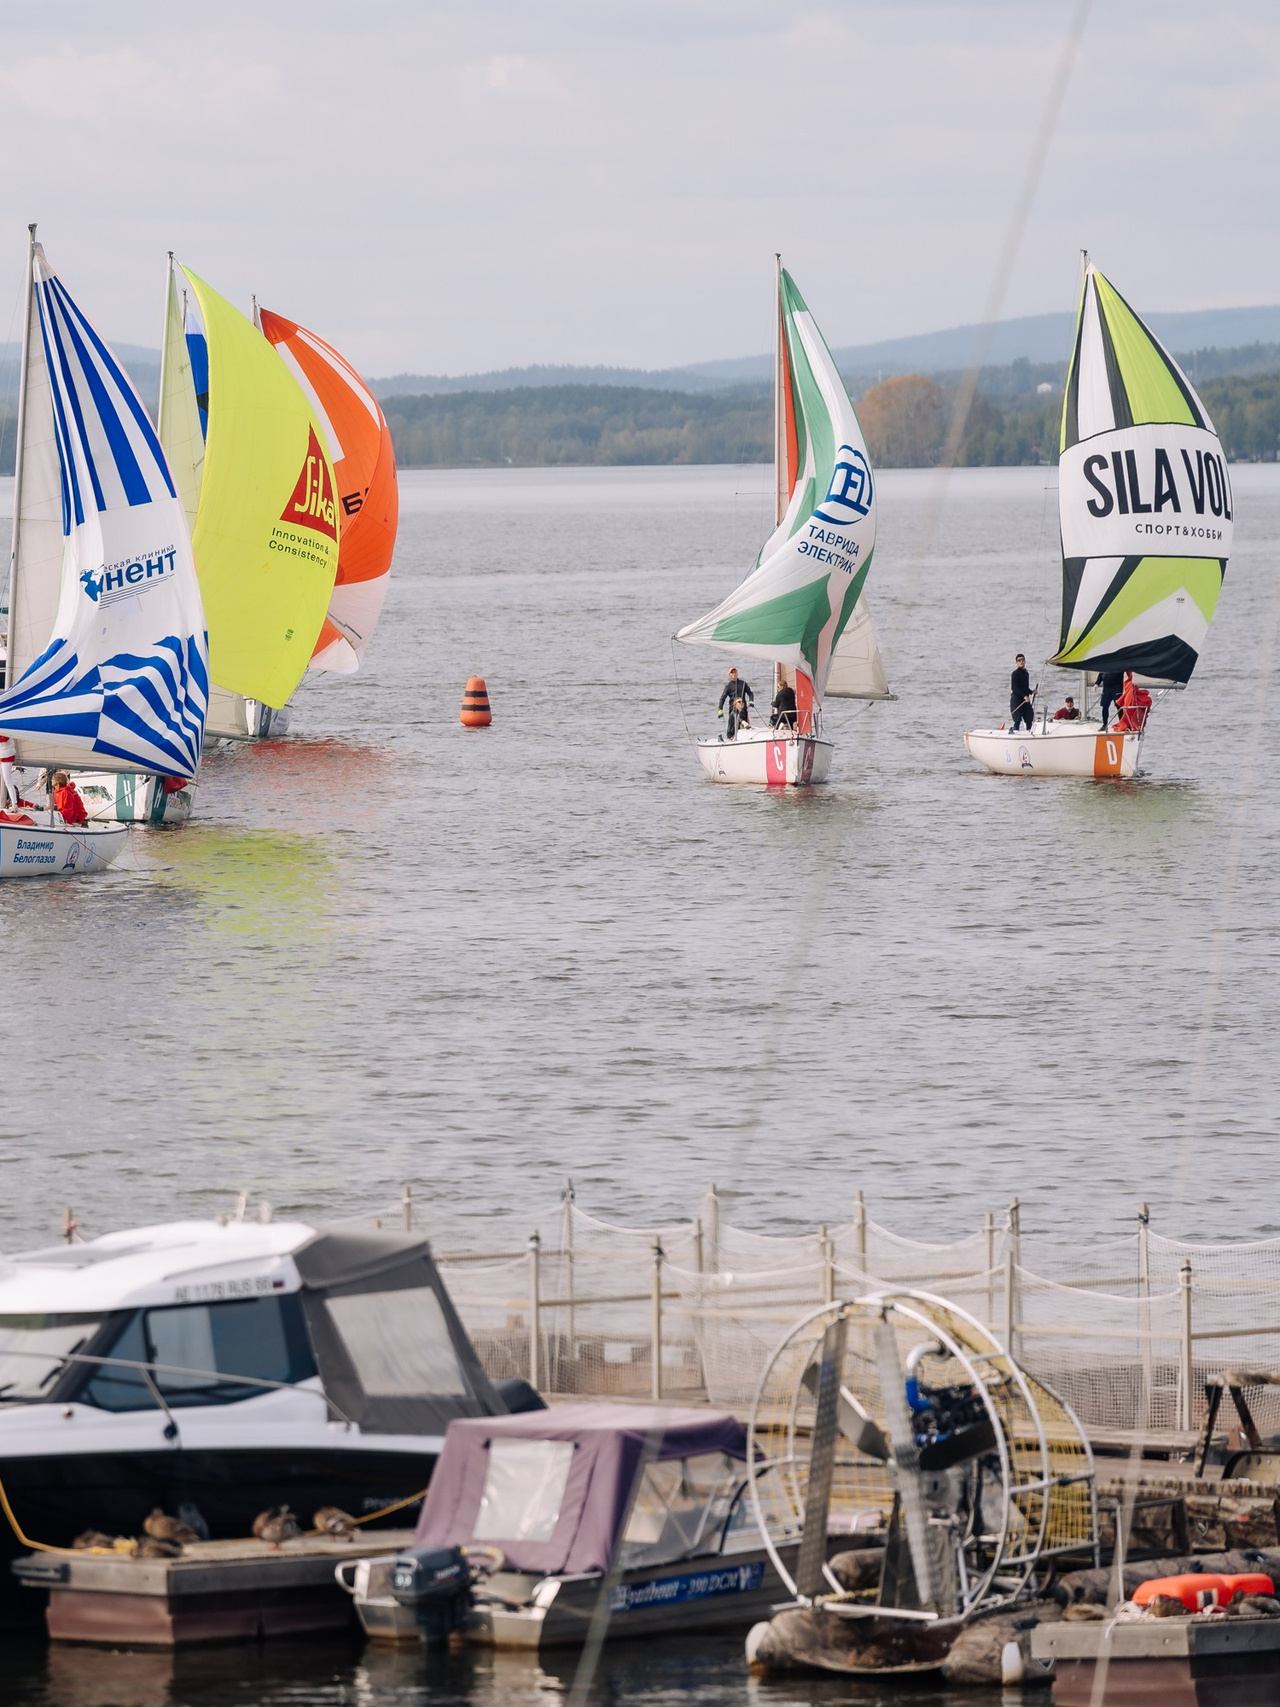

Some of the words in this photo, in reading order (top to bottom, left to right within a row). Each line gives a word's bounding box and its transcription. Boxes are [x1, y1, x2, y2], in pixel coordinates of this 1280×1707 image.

[294, 456, 335, 528] Sika
[1083, 448, 1181, 518] SILA
[271, 527, 325, 552] Innovation
[809, 525, 860, 557] ТАВРИДА
[1135, 523, 1222, 541] СПОРТ&ХОББИ
[97, 558, 131, 573] еская
[135, 544, 175, 562] клиника
[268, 540, 328, 569] Consistency
[797, 541, 856, 575] ЭЛЕКТРИК
[773, 745, 784, 771] C
[1106, 740, 1118, 766] D
[123, 780, 133, 807] H
[13, 853, 56, 865] Белоглазов
[16, 839, 55, 852] Владимир
